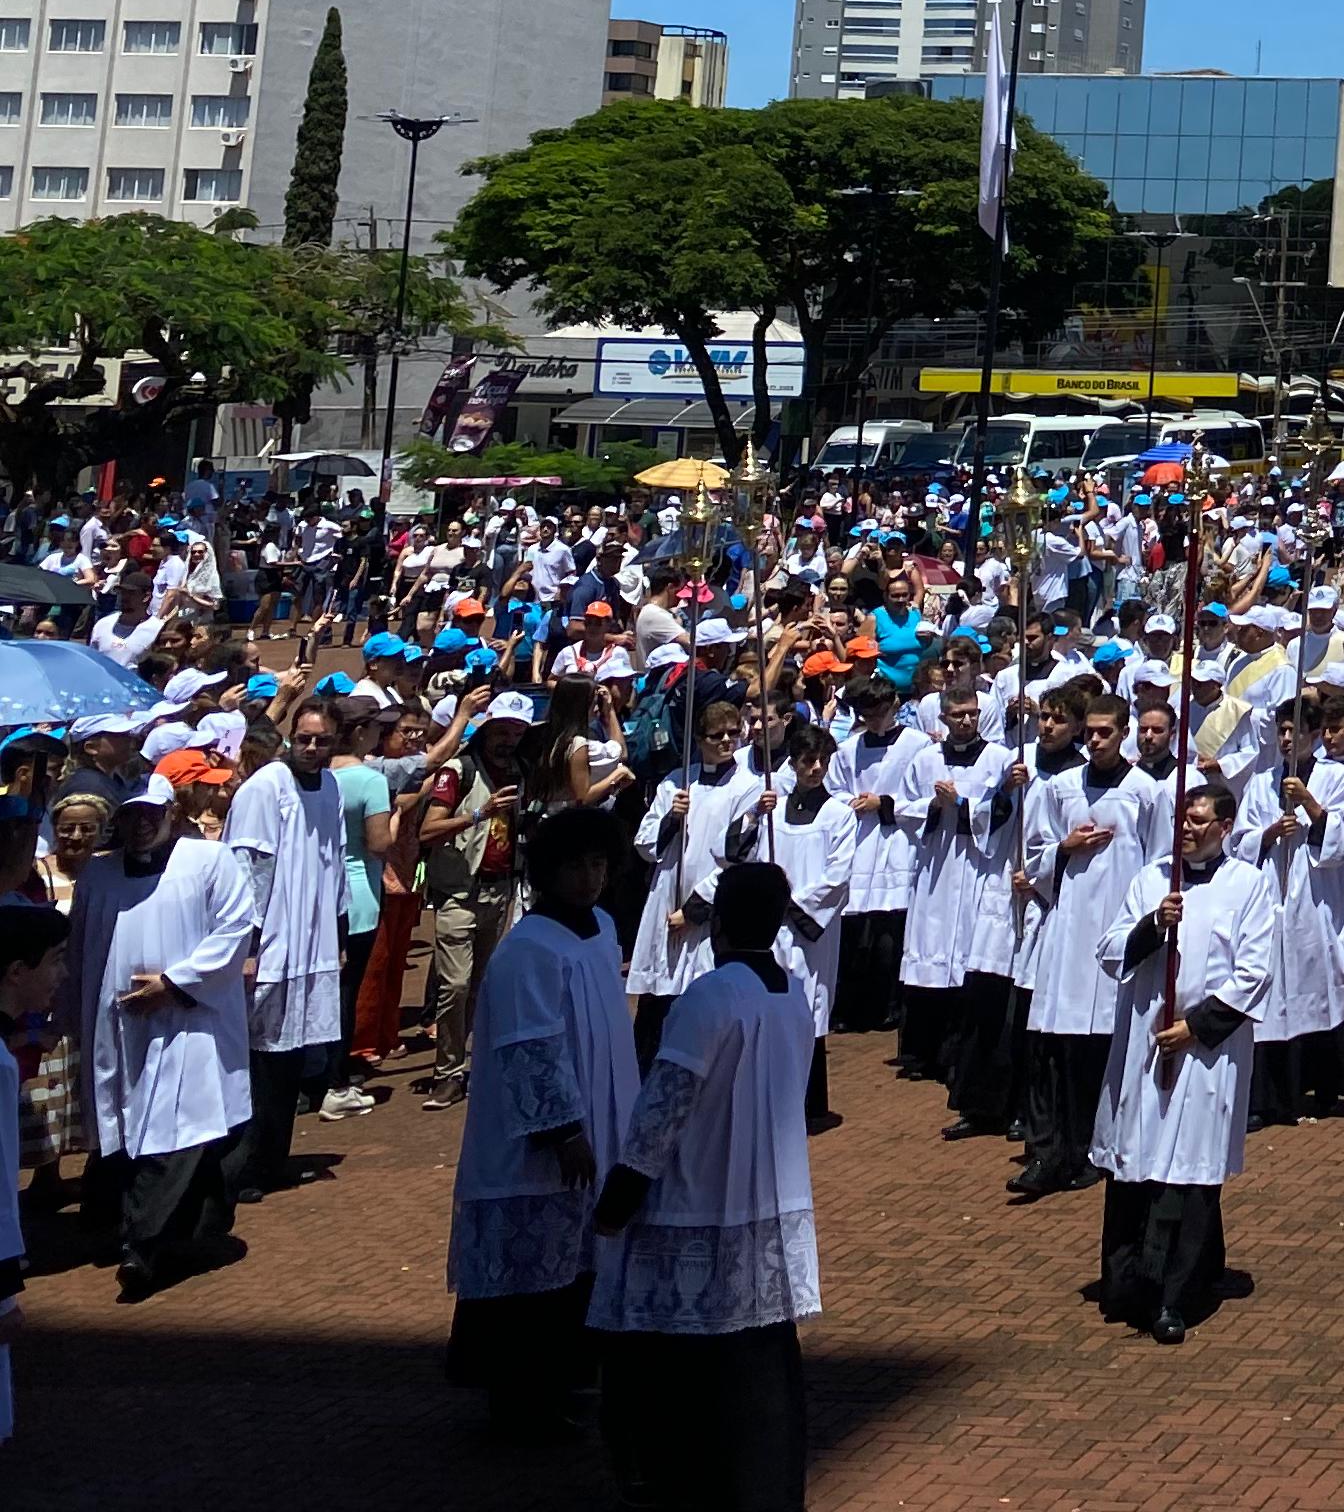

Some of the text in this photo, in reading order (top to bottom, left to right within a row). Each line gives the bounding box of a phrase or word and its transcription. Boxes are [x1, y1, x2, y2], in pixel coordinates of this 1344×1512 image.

[1057, 378, 1140, 391] BANCO DO BRASIL
